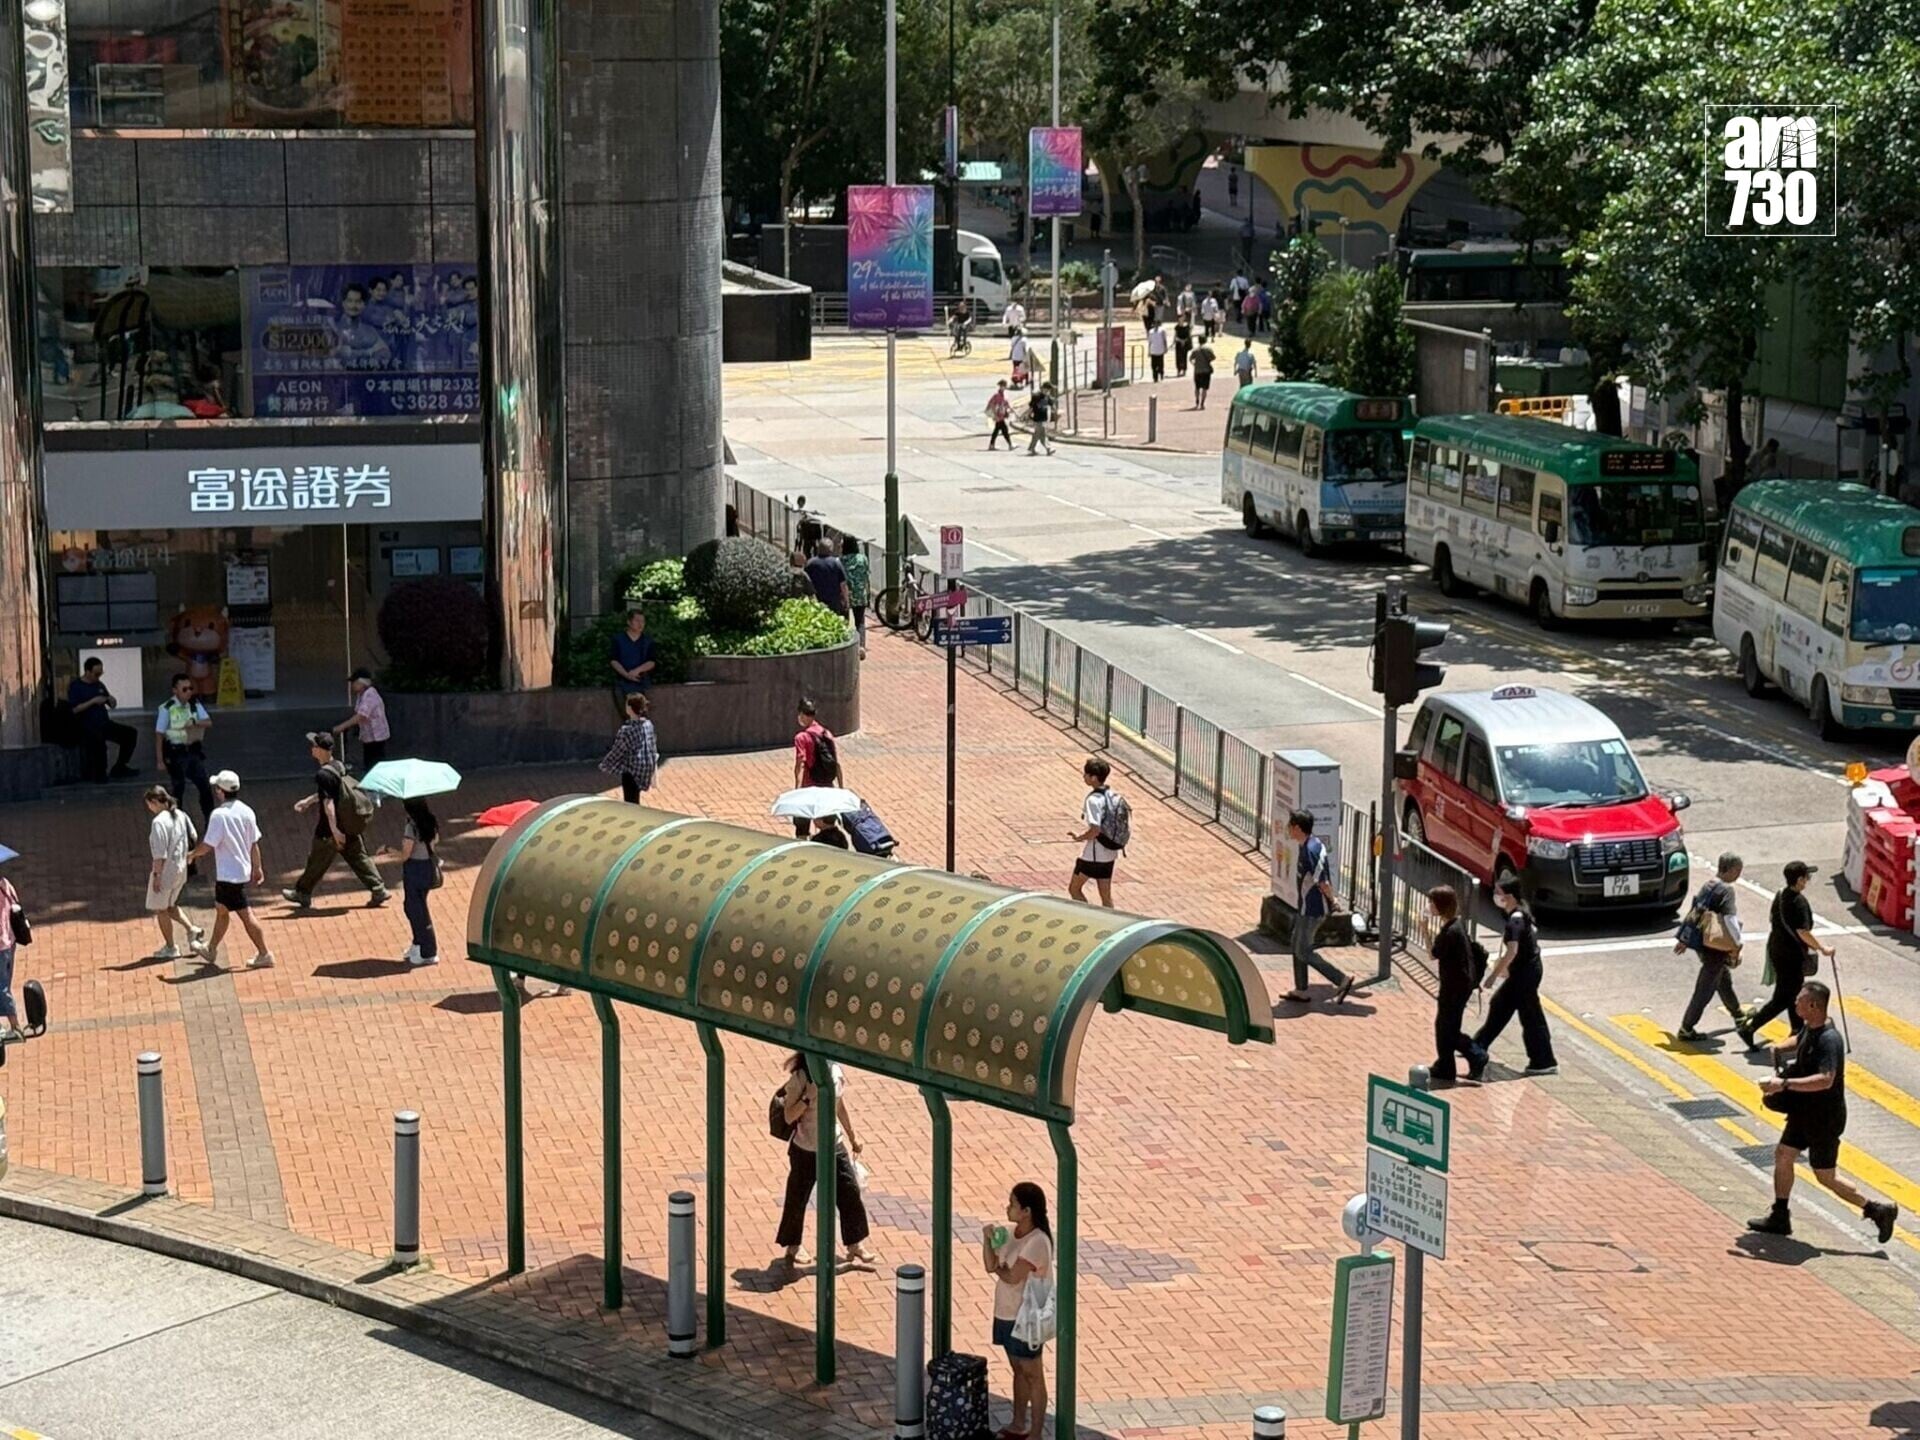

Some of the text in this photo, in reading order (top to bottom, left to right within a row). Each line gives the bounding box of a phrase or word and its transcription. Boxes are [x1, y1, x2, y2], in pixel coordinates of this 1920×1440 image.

[874, 266, 928, 280] Anniversary
[268, 331, 334, 350] $12,000
[276, 380, 322, 393] AEON
[407, 394, 448, 410] 3628
[187, 463, 392, 512] 富途證券
[1499, 686, 1531, 696] TAXI
[1614, 875, 1629, 885] PP
[1612, 885, 1631, 896] 178
